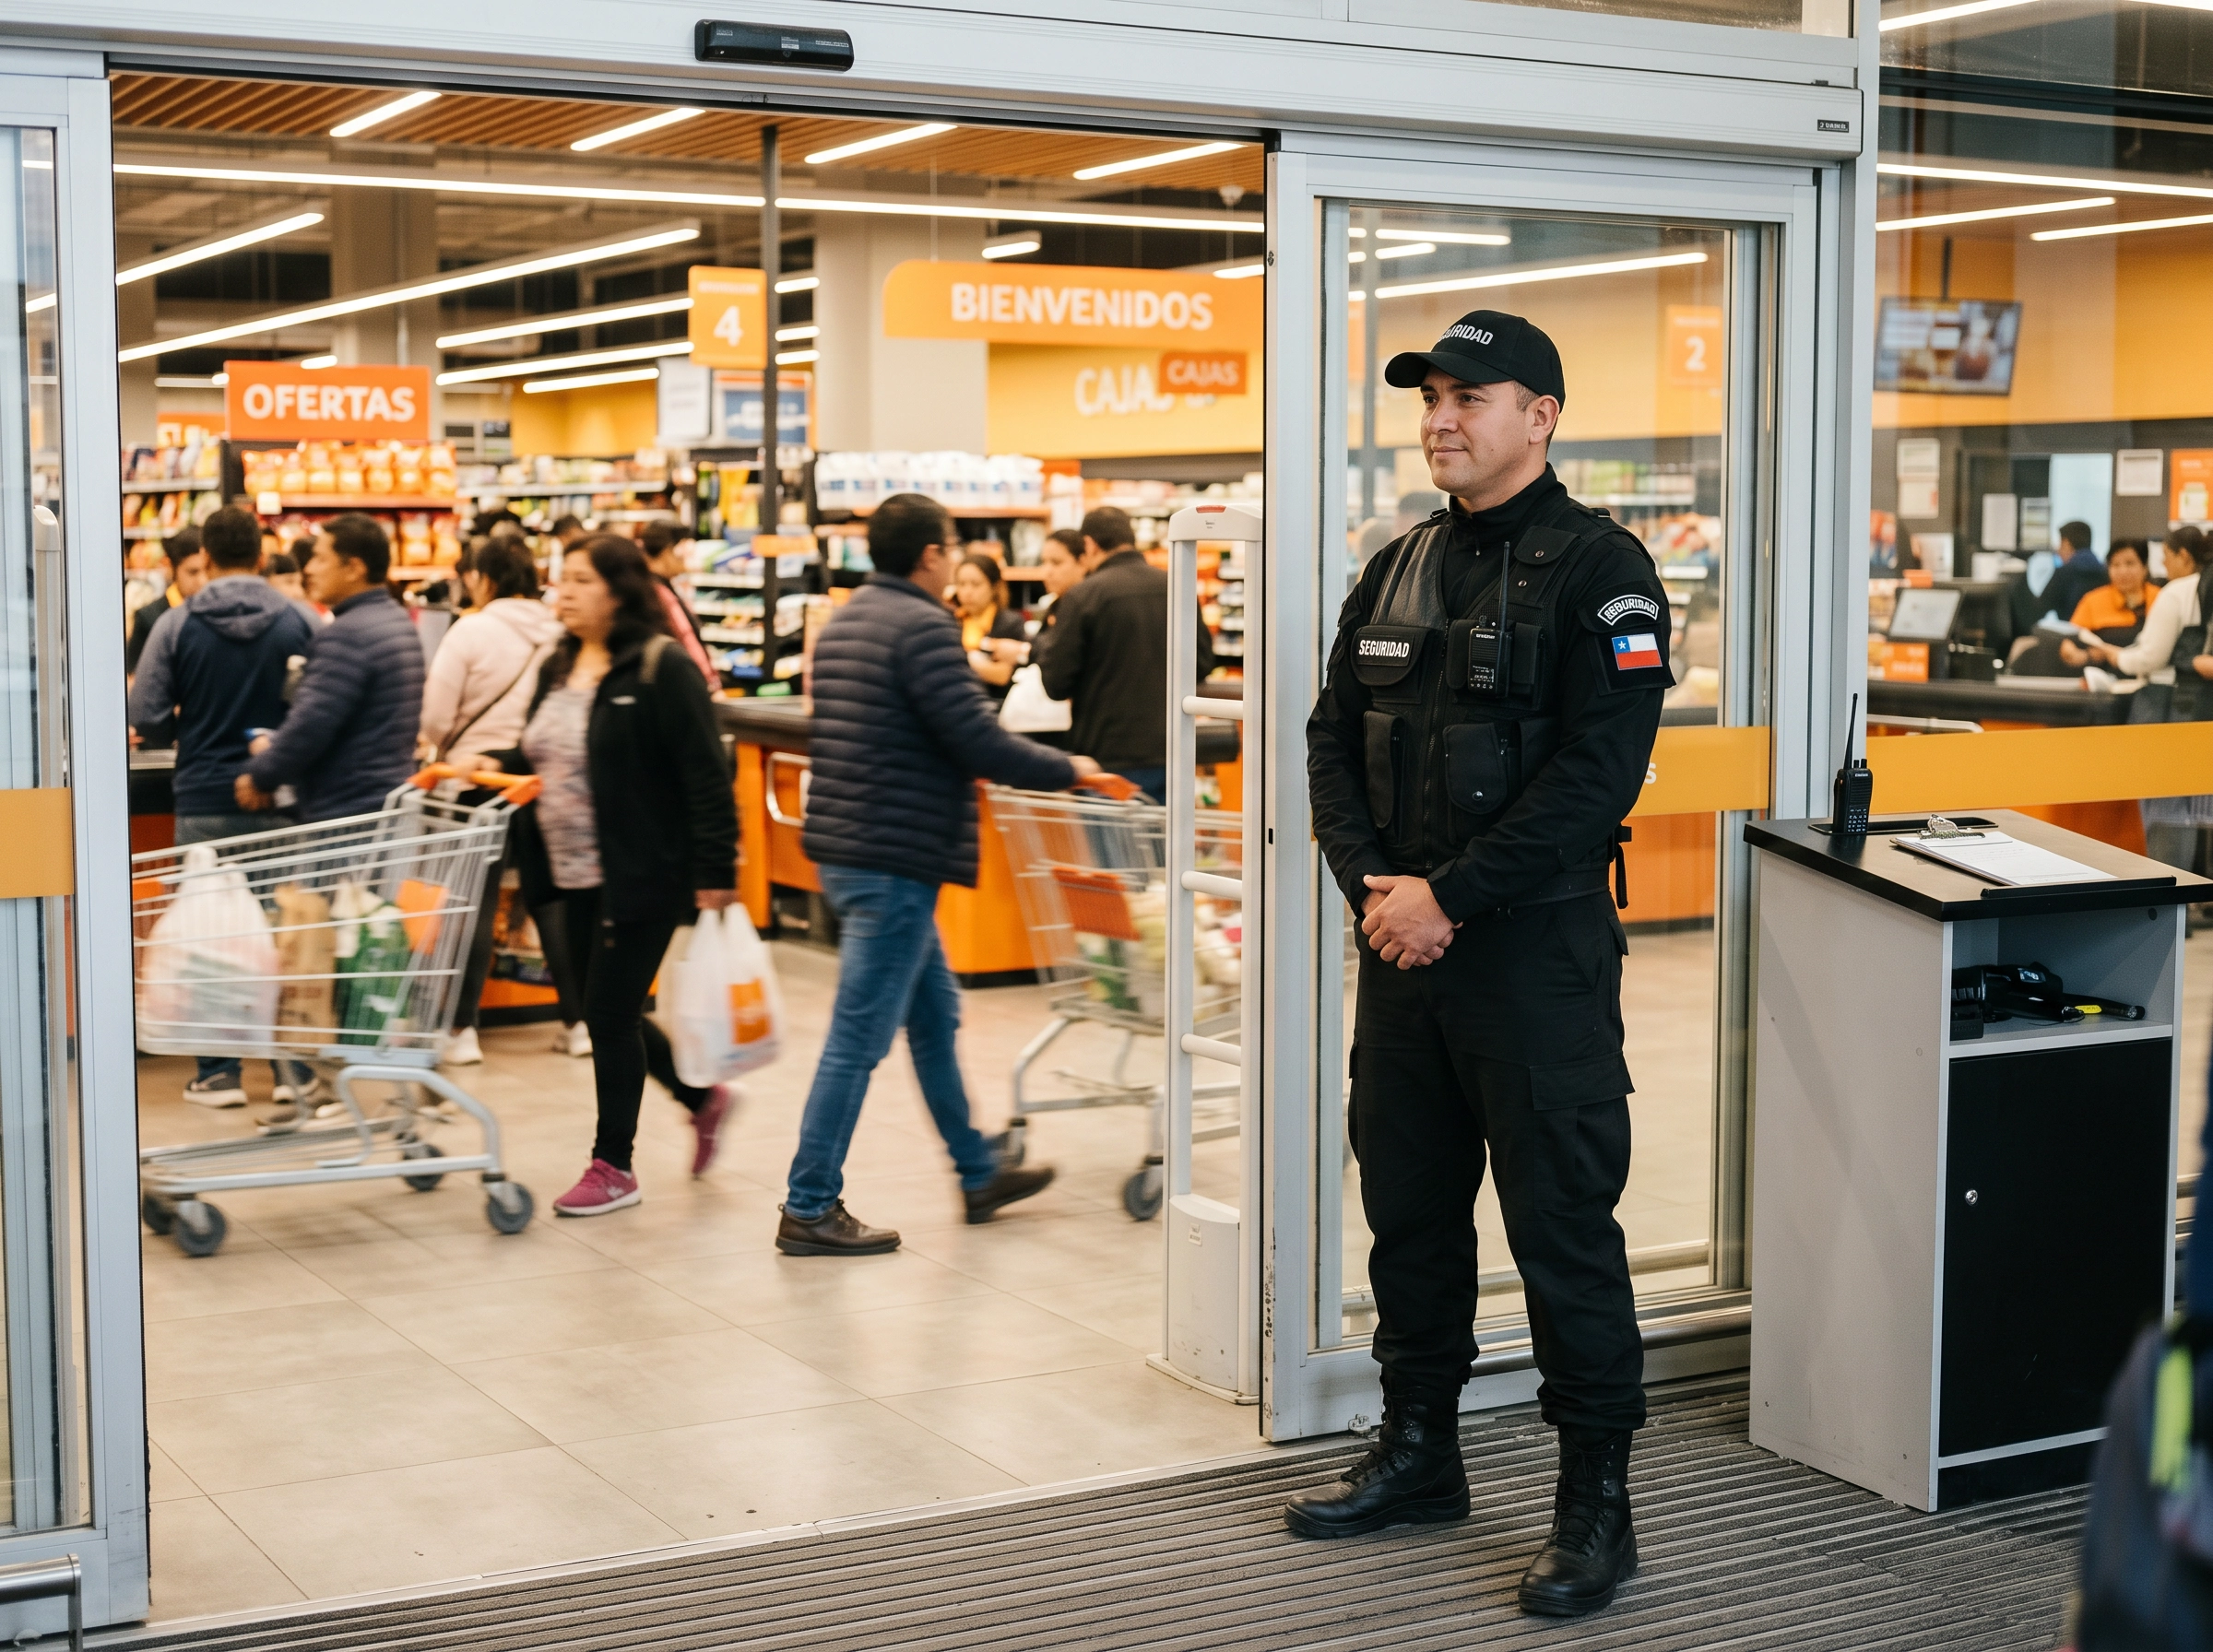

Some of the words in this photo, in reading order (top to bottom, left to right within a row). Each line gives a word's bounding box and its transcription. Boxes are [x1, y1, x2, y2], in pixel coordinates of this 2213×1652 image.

[951, 282, 1213, 331] BIENVENIDOS
[714, 305, 744, 347] 4
[1166, 359, 1239, 387] CAJAS
[1685, 336, 1707, 372] 2
[243, 383, 416, 423] OFERTAS
[1358, 639, 1410, 658] SEGURIDAD
